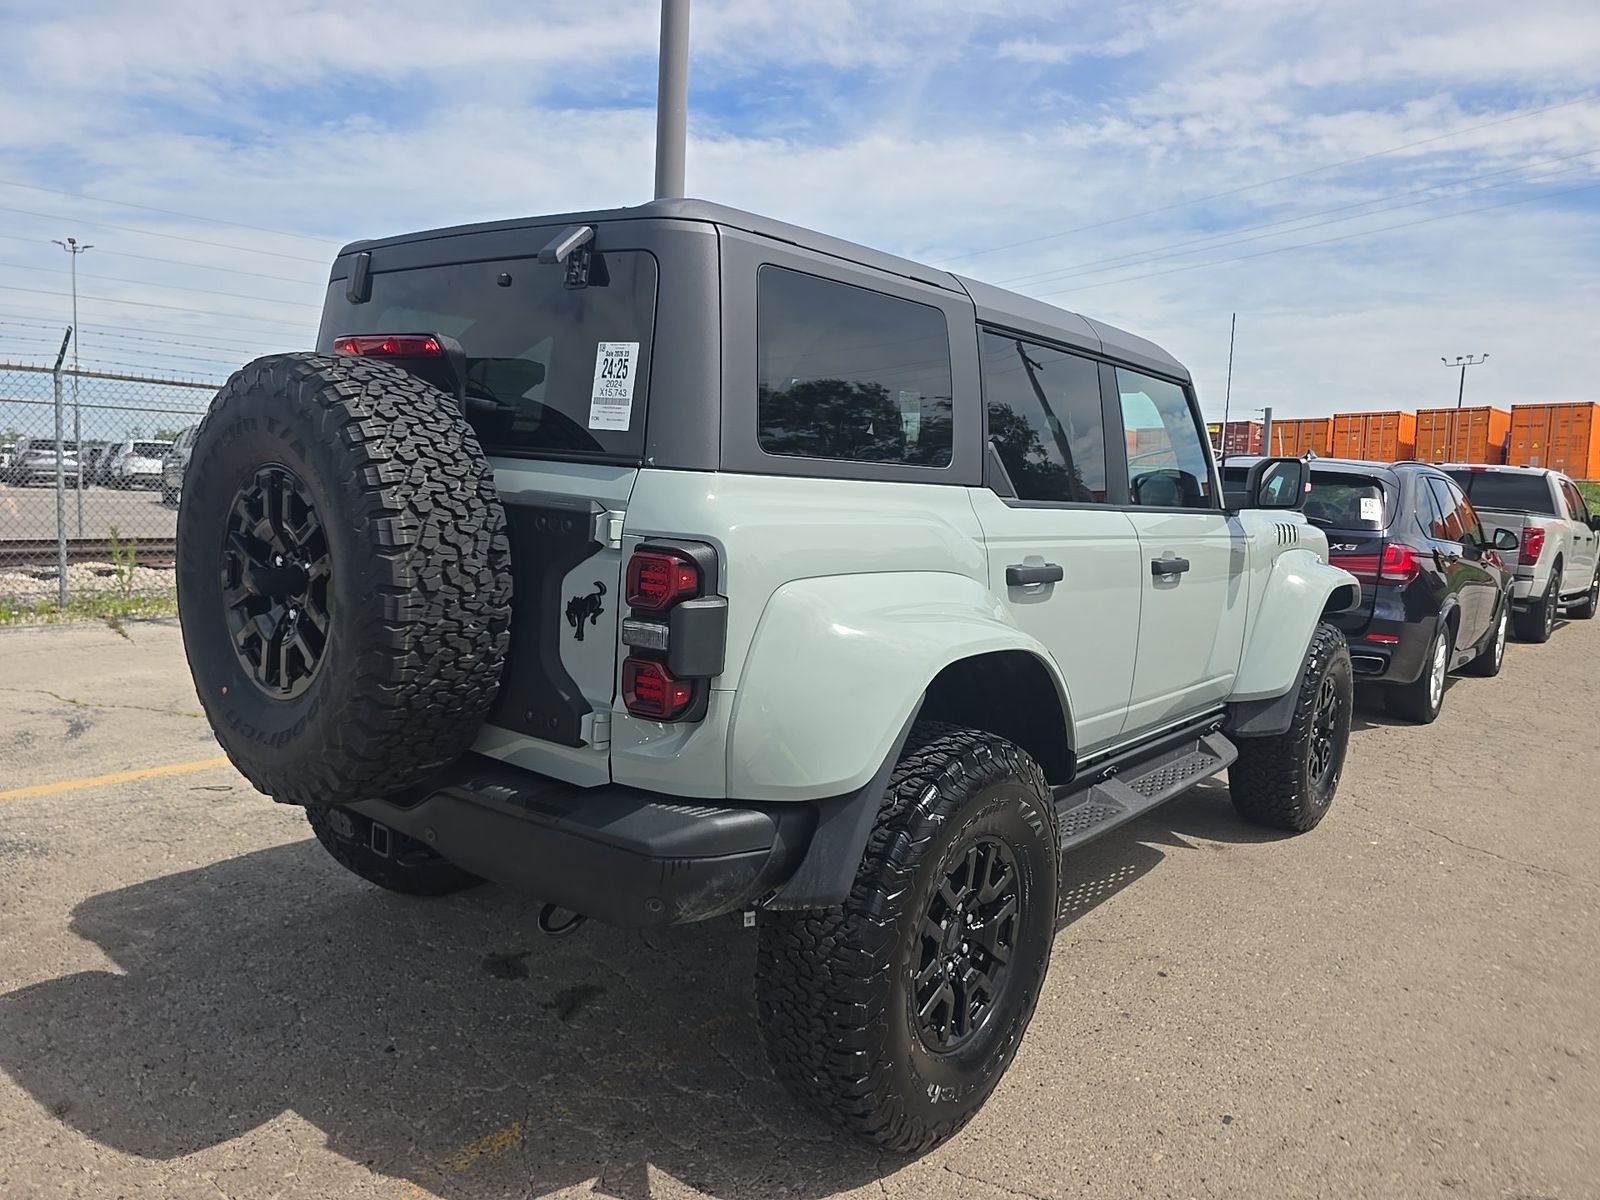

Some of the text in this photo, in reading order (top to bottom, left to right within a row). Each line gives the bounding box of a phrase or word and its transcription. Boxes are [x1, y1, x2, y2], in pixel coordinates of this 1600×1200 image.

[602, 358, 629, 379] 24:25
[605, 380, 622, 388] 2024
[600, 388, 627, 398] X15,743
[1330, 543, 1358, 551] X5
